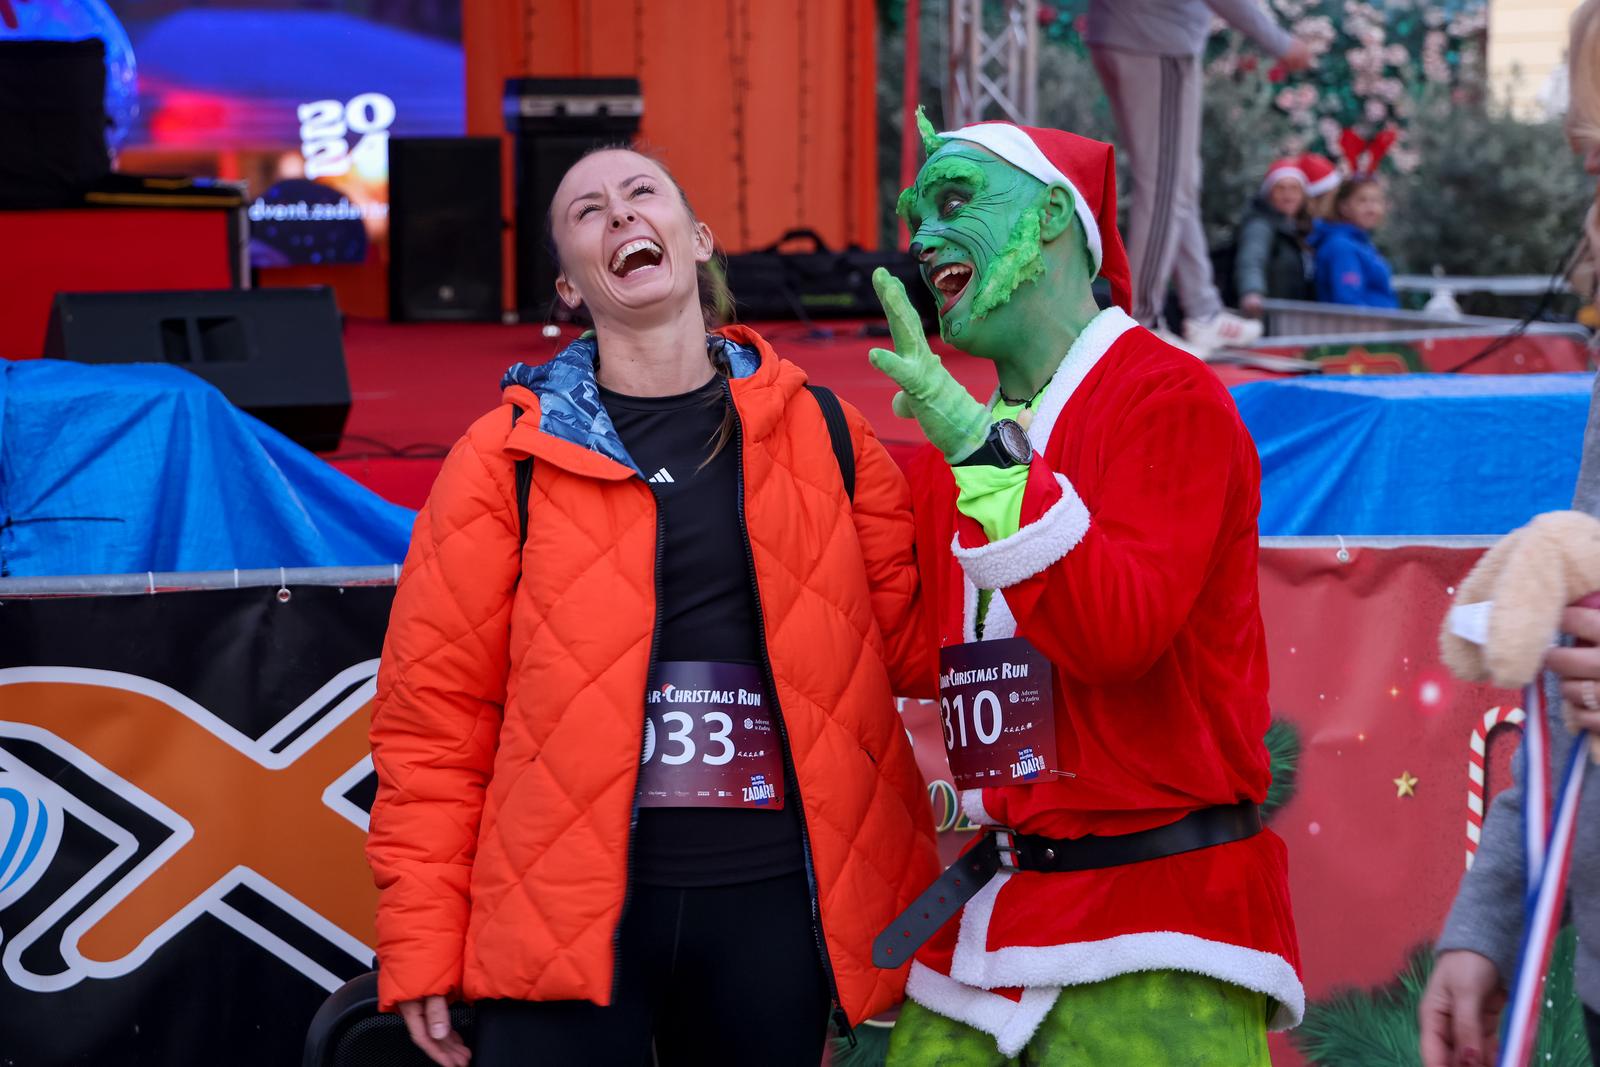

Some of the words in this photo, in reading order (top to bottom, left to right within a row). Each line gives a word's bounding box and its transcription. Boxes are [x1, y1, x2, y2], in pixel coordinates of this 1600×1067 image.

[297, 92, 396, 143] 20
[301, 130, 390, 180] 24
[663, 684, 735, 704] CHRISTMAS
[738, 688, 761, 706] RUN
[1002, 662, 1028, 680] RUN
[942, 690, 1003, 750] 310
